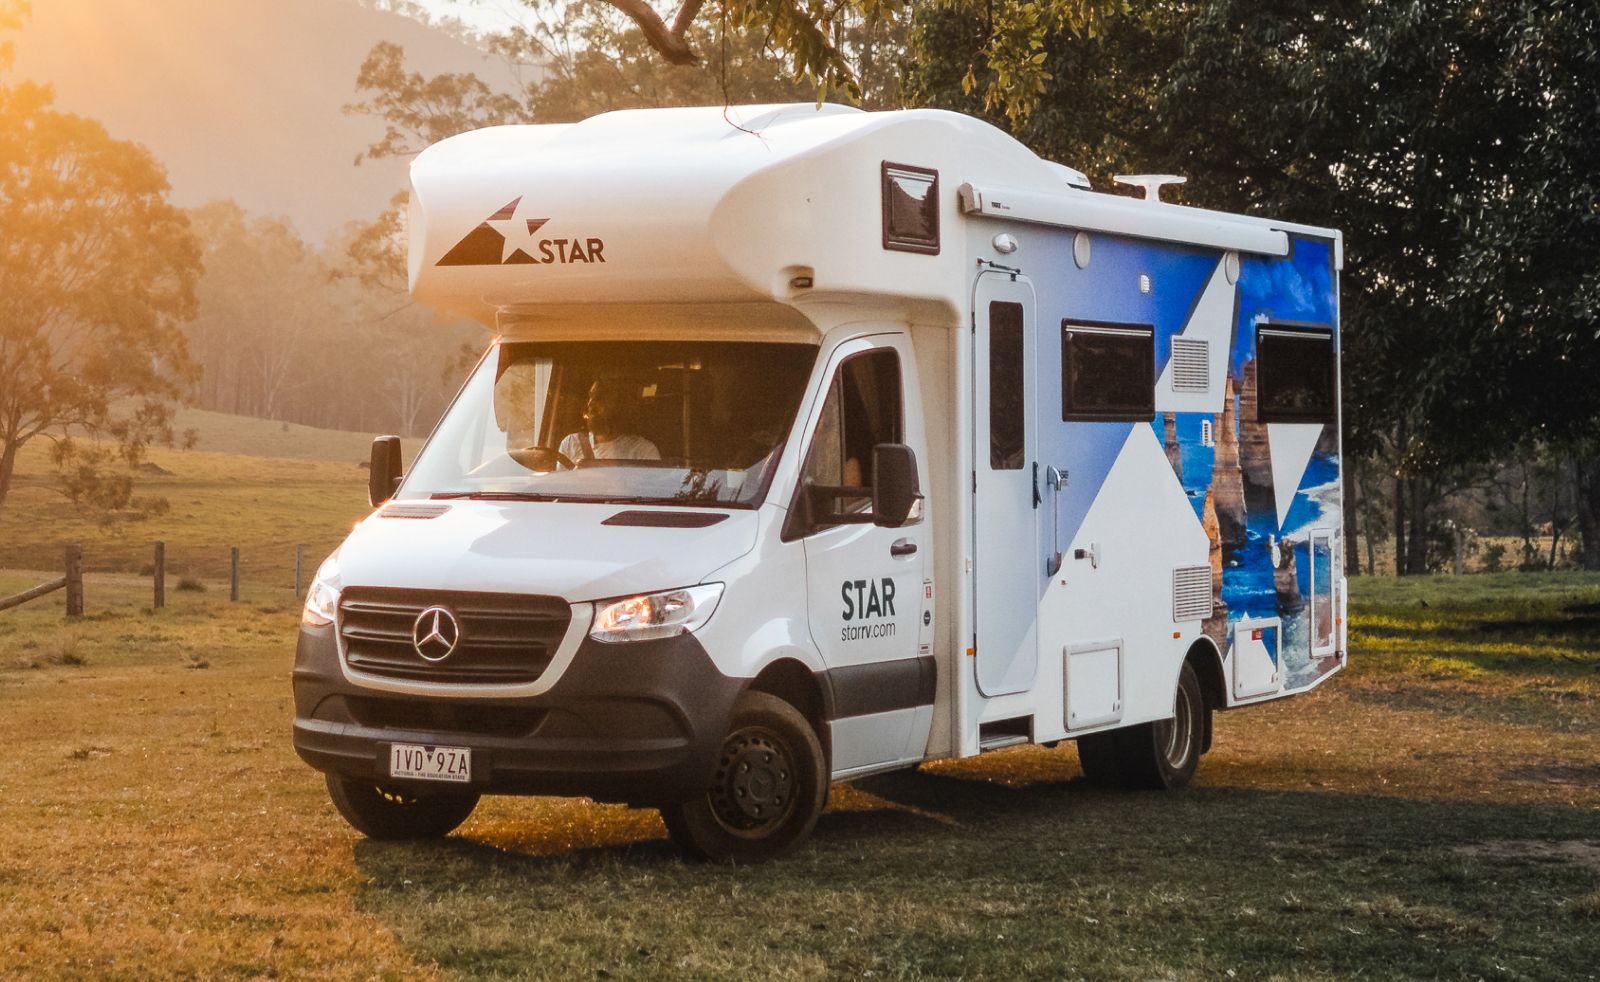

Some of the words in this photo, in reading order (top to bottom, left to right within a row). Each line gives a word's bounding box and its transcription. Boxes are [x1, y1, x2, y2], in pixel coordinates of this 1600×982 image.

[539, 238, 606, 264] STAR
[841, 577, 895, 621] STAR
[841, 622, 896, 642] starrv.com
[396, 749, 423, 771] 1VD
[437, 752, 468, 775] 9ZA
